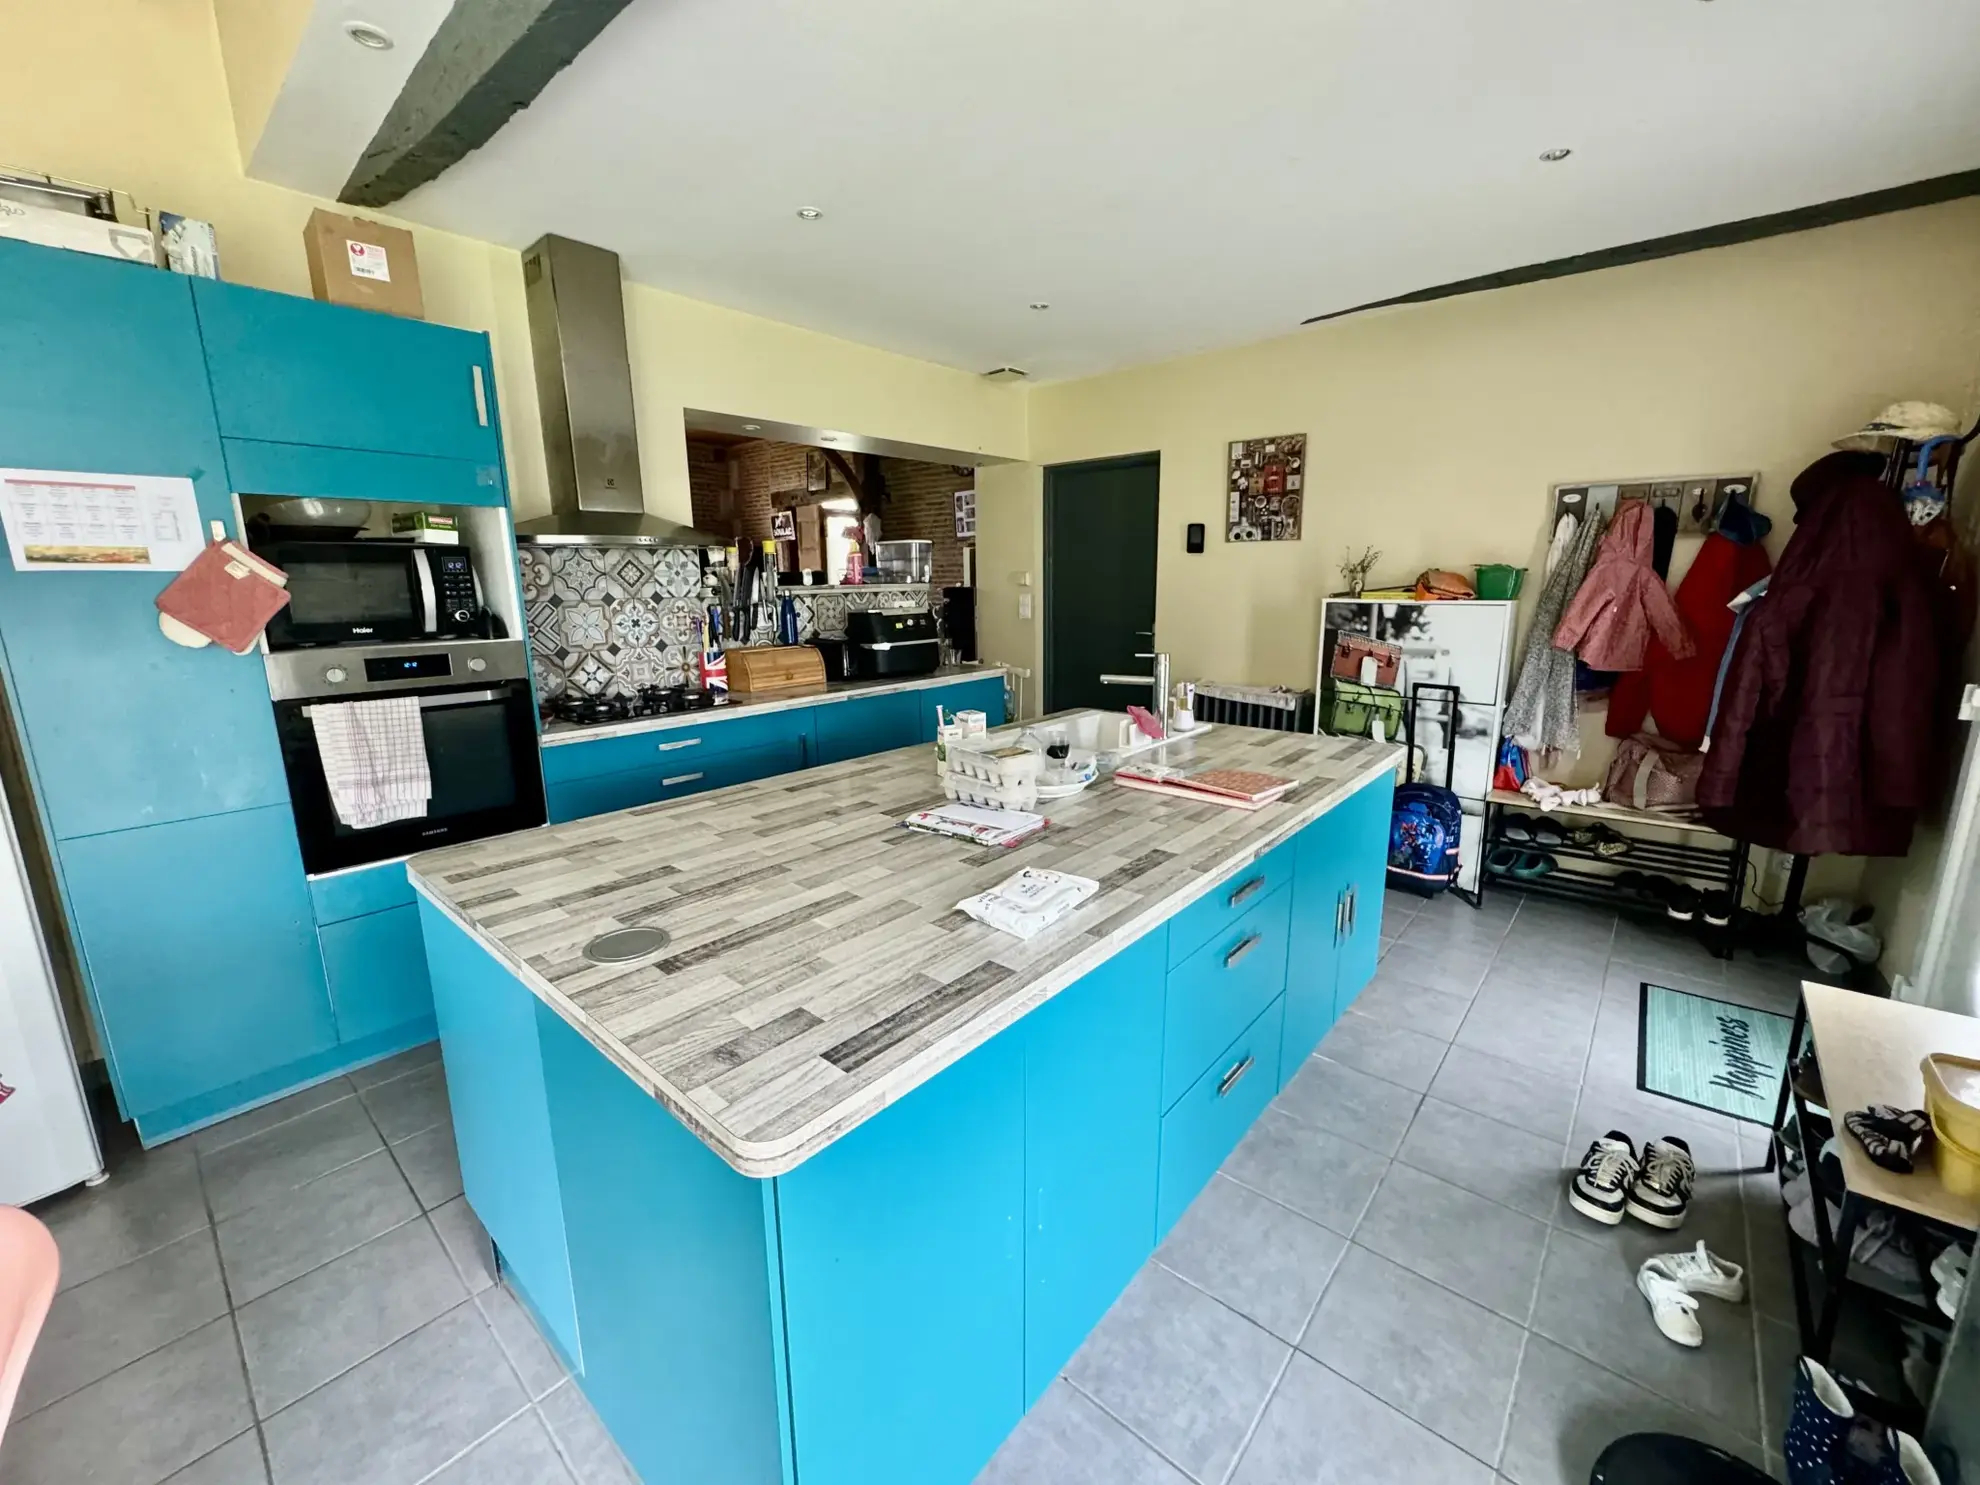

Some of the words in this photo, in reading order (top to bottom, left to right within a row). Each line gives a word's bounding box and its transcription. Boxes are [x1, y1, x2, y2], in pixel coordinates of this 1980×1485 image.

[352, 626, 374, 634] Haier
[422, 828, 447, 836] SAMSUNG
[1708, 1015, 1776, 1100] Happiness
